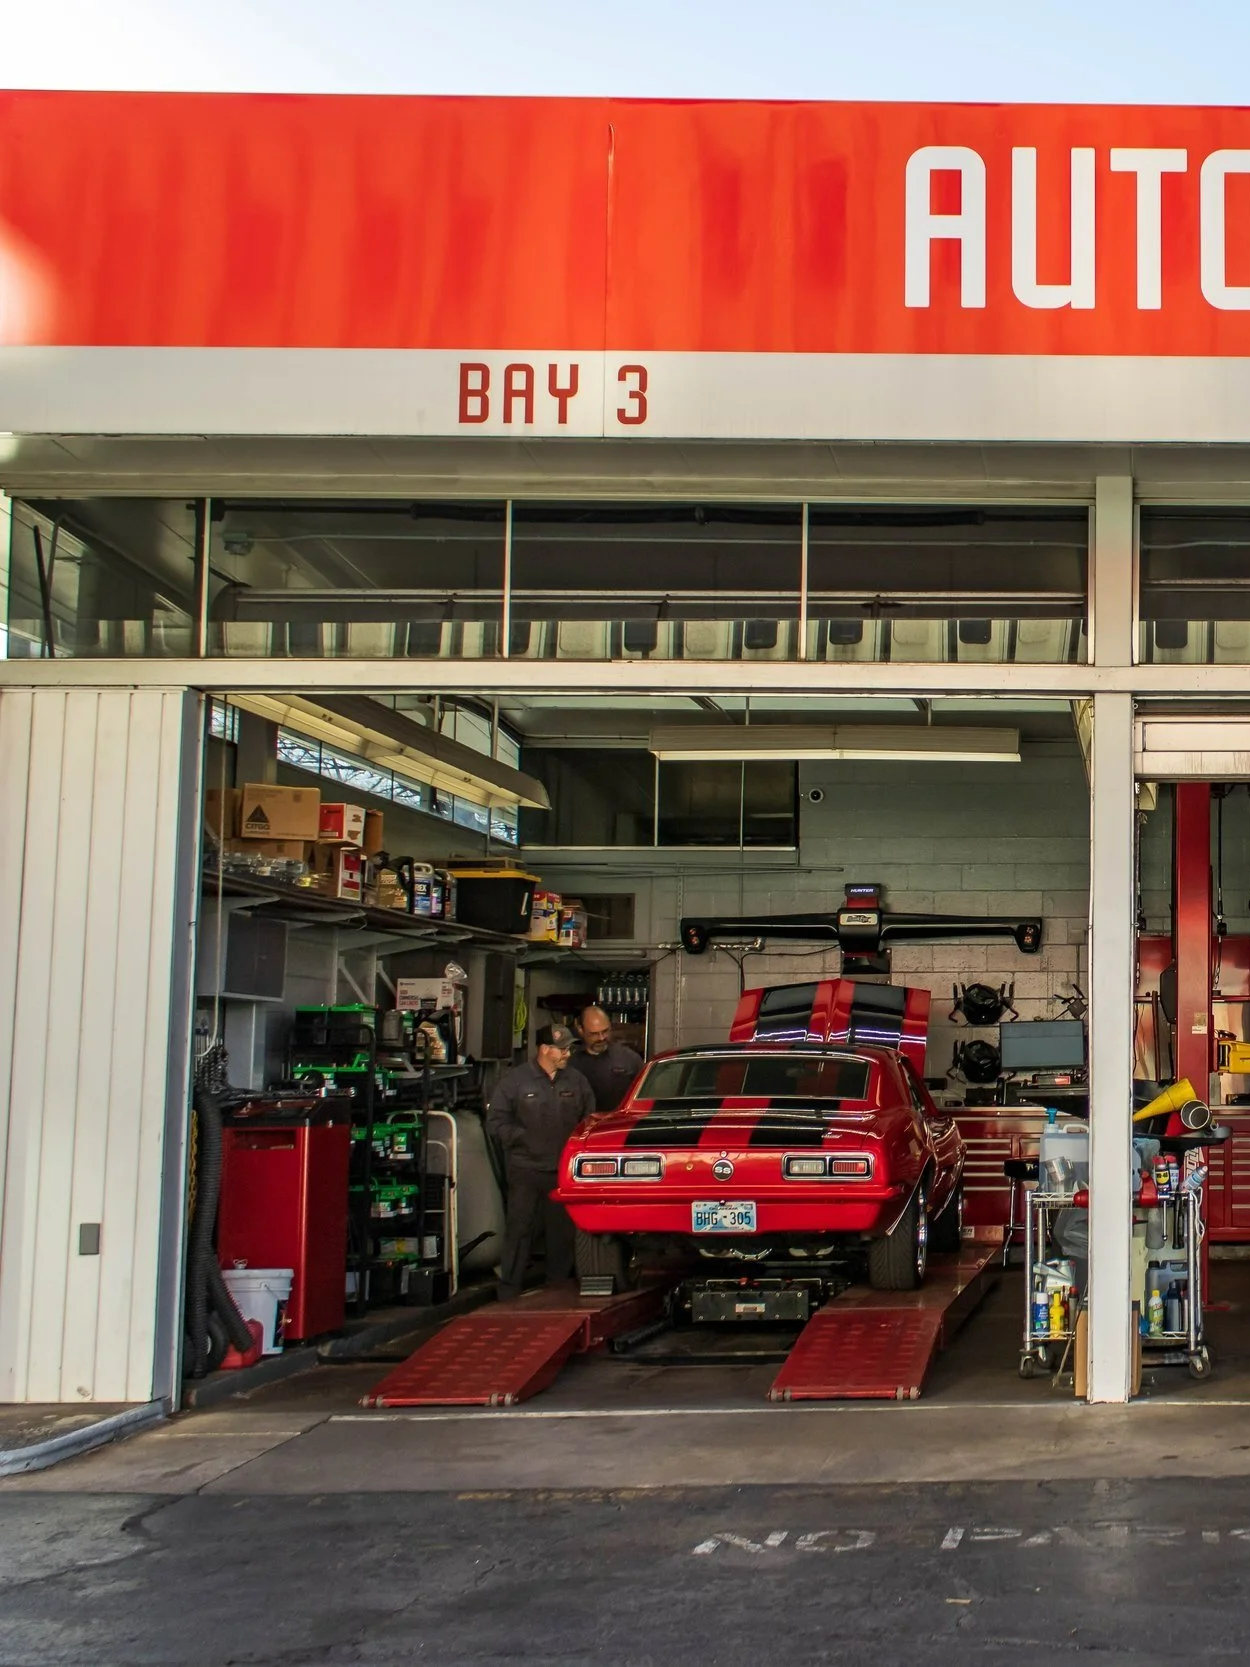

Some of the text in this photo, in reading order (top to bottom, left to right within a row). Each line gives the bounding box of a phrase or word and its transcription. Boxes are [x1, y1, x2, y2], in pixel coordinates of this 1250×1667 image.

[458, 362, 649, 426] BAY 3
[714, 1166, 731, 1174] SS
[690, 1529, 877, 1556] NO
